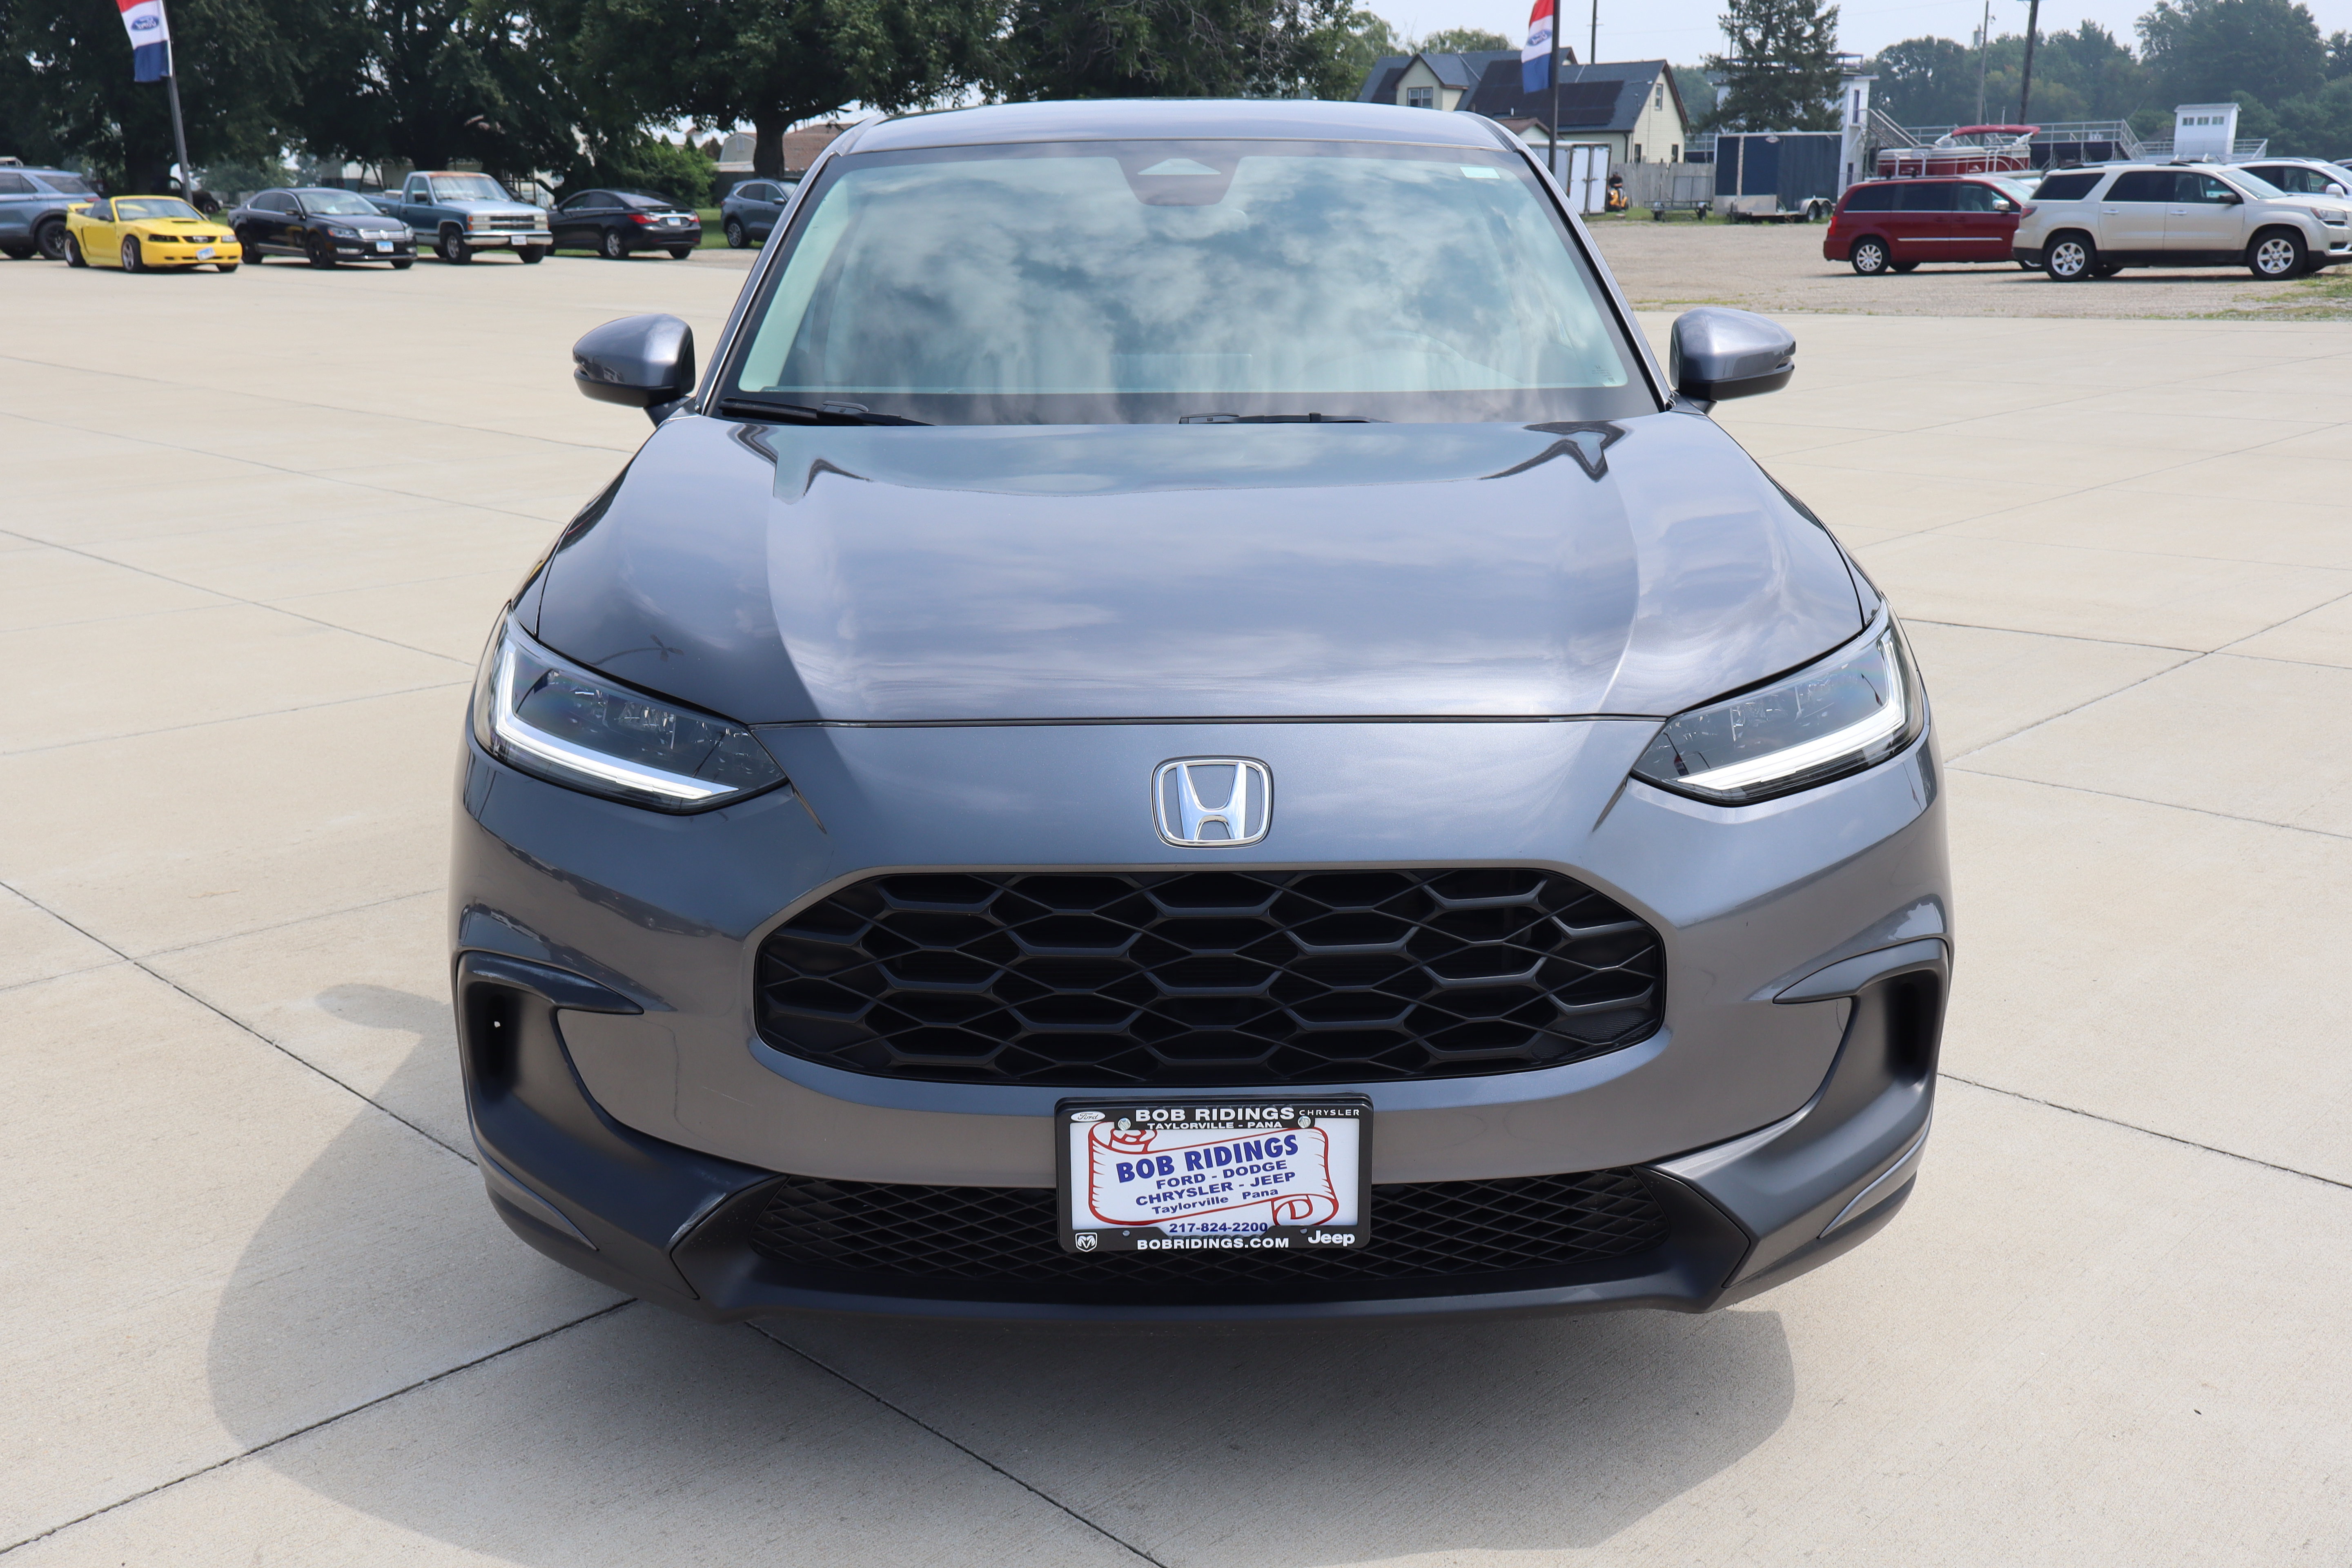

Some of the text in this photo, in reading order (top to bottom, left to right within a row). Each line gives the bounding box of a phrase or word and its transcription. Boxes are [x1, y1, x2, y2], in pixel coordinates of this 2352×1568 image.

[1136, 1107, 1295, 1122] BOB RIDINGS
[1147, 1122, 1234, 1130] TAYLORVILLE
[1116, 1135, 1298, 1183] BOB RIDINGS
[1156, 1174, 1206, 1189] FORD
[1223, 1160, 1288, 1179] DODGE
[1136, 1182, 1234, 1206] CHRYSLER
[1250, 1172, 1296, 1187] JEEP
[1152, 1189, 1278, 1214] Taylorville Pana
[1169, 1223, 1268, 1233] 217-824-2200
[1137, 1238, 1289, 1250] BOBRIDINGS.COM
[1308, 1230, 1355, 1247] Jeep
